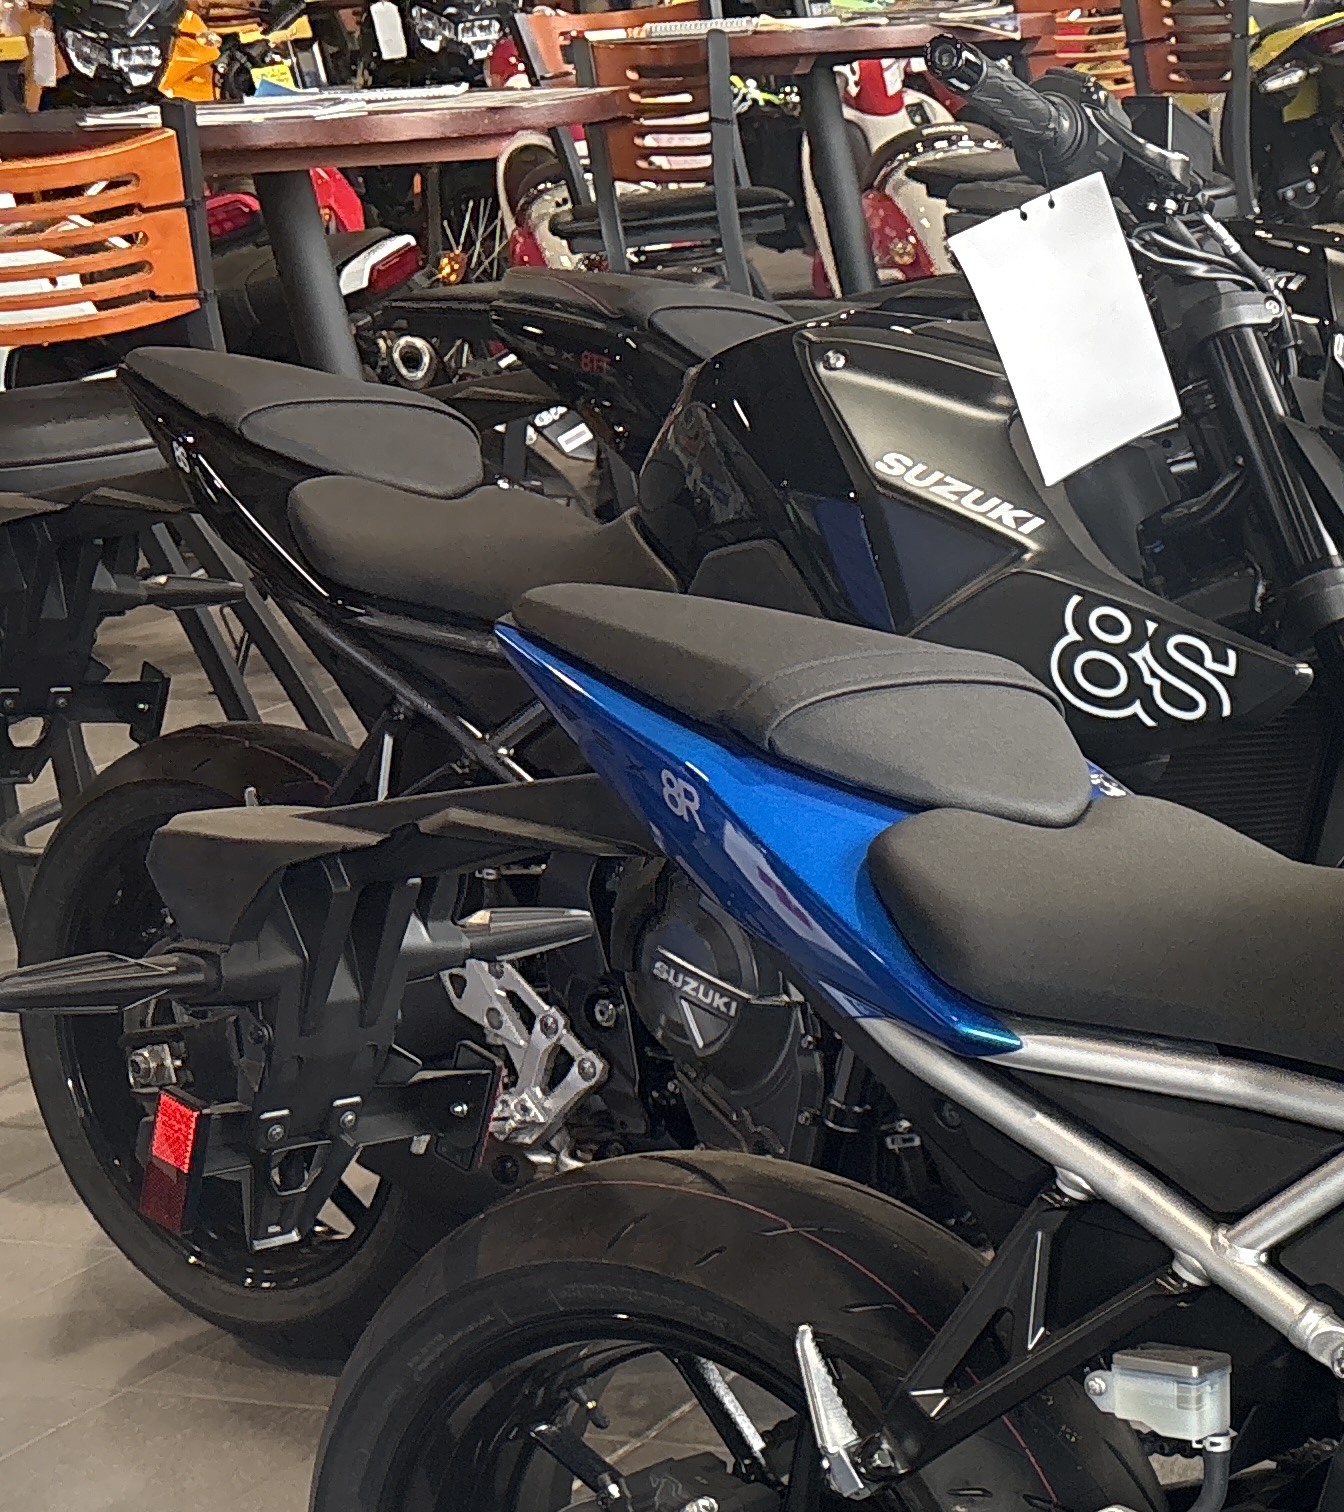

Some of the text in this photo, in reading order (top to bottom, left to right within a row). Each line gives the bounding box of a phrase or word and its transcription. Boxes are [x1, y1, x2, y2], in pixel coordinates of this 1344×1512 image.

[875, 452, 1046, 535] SUZUKI
[660, 769, 706, 833] 8R
[652, 960, 738, 1018] SUZUKI
